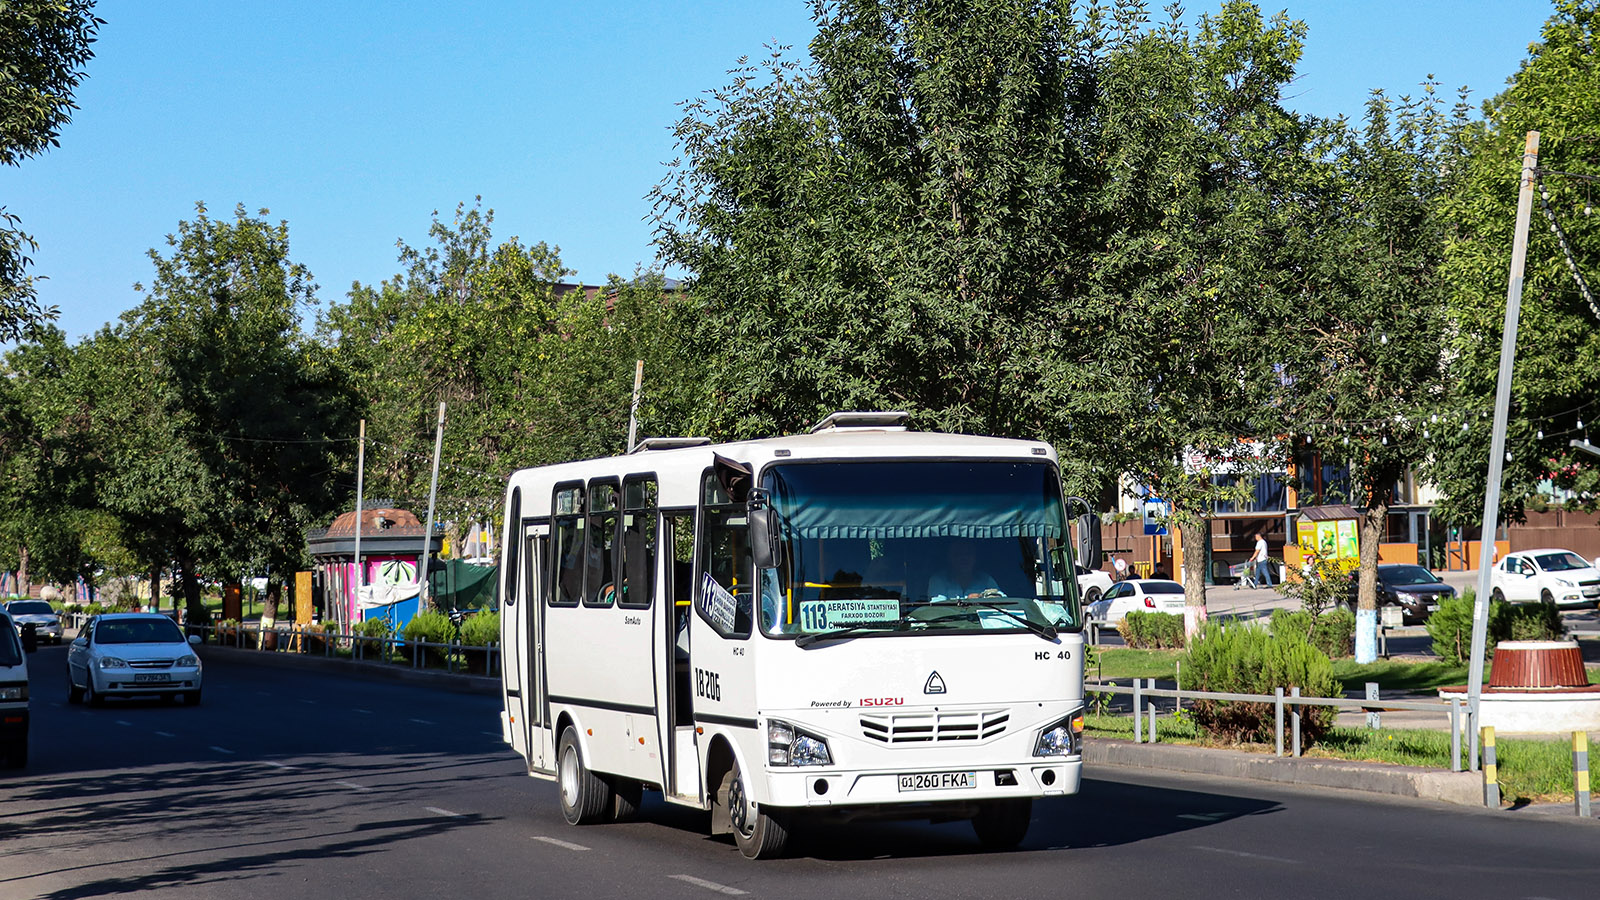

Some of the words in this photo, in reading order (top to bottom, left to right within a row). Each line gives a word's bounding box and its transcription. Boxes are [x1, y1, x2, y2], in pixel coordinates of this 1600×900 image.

[701, 575, 717, 617] 113
[827, 602, 866, 612] AERATSIYA
[802, 603, 827, 630] 113
[1035, 651, 1050, 661] HC
[1057, 651, 1071, 660] 40
[811, 700, 842, 708] Powered
[843, 701, 853, 709] by
[859, 697, 904, 707] ISUZU
[901, 777, 914, 788] 01
[916, 774, 939, 789] 260
[942, 773, 968, 788] FKA
